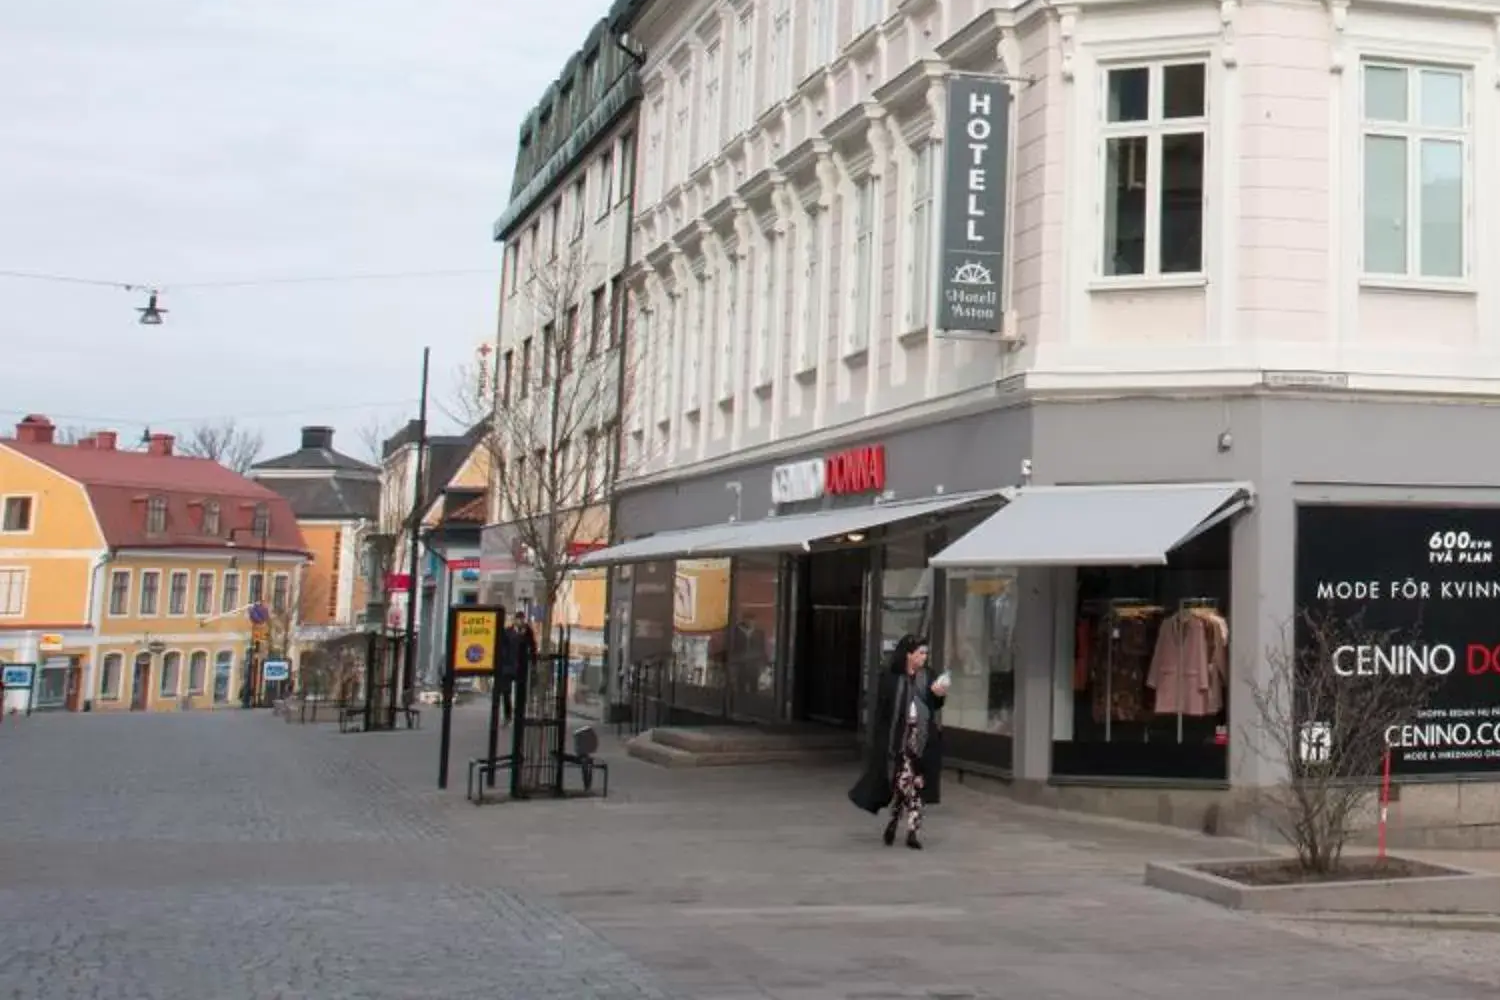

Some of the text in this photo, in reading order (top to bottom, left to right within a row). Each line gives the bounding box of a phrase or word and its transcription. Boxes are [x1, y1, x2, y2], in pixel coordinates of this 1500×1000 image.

[966, 93, 991, 242] HOTELL
[951, 304, 994, 319] Aston
[825, 443, 885, 494] DONNA
[1430, 551, 1493, 563] TVÅ PLAN
[1317, 580, 1380, 599] MODE
[1391, 577, 1431, 599] FÖR
[1332, 643, 1456, 676] CENINO
